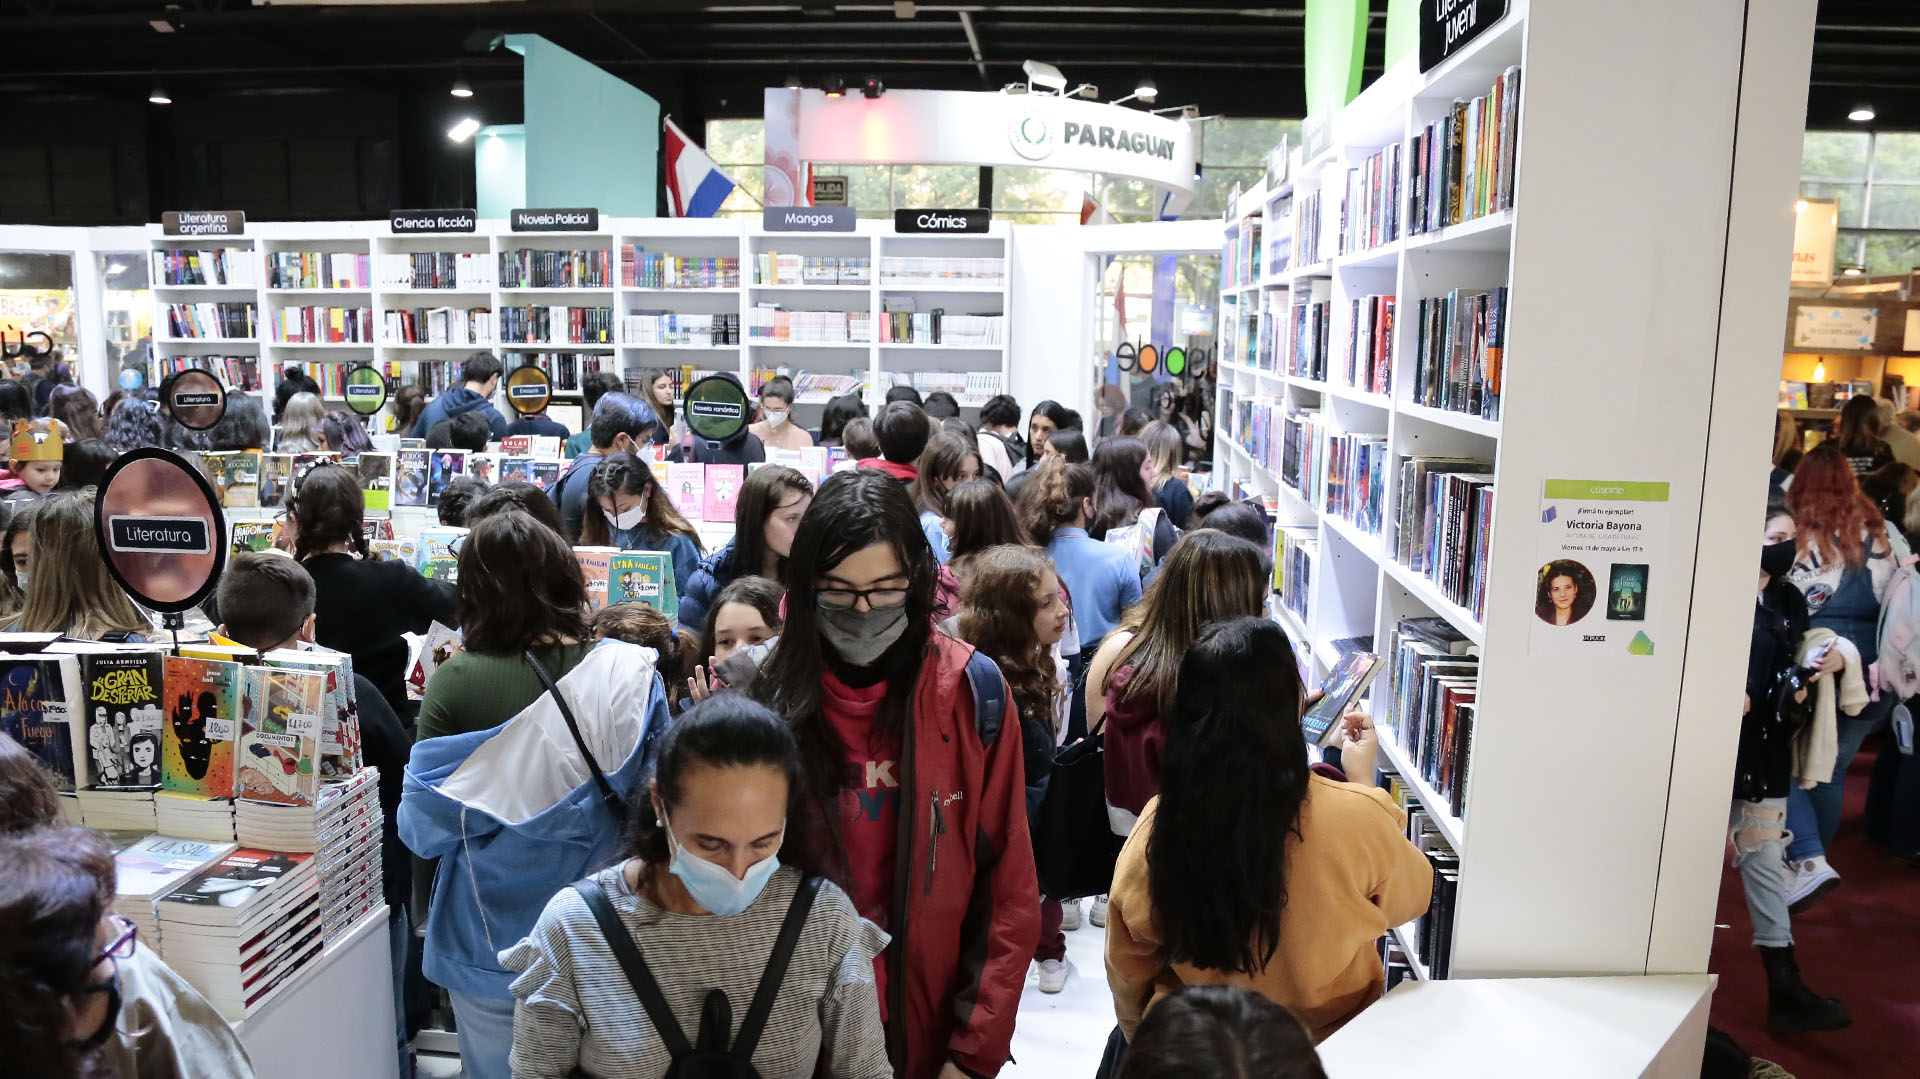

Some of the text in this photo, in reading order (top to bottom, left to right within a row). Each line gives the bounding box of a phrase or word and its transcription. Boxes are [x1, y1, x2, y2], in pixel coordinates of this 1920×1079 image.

[1443, 1, 1477, 56] juvenil
[1064, 121, 1175, 161] PARAGUAY
[179, 213, 228, 224] Literatura
[393, 215, 473, 229] Ciencia ficción
[519, 212, 590, 225] Novela Policial
[785, 212, 833, 227] Mangas
[917, 212, 967, 229] Cómics
[179, 223, 228, 236] argentina
[234, 525, 262, 537] DRAGON
[1566, 519, 1642, 532] Victoria Bayona
[126, 526, 192, 543] Literatura
[104, 668, 149, 690] GRAN
[90, 680, 159, 705] DESPERTAR
[146, 840, 211, 857] LA SAL
